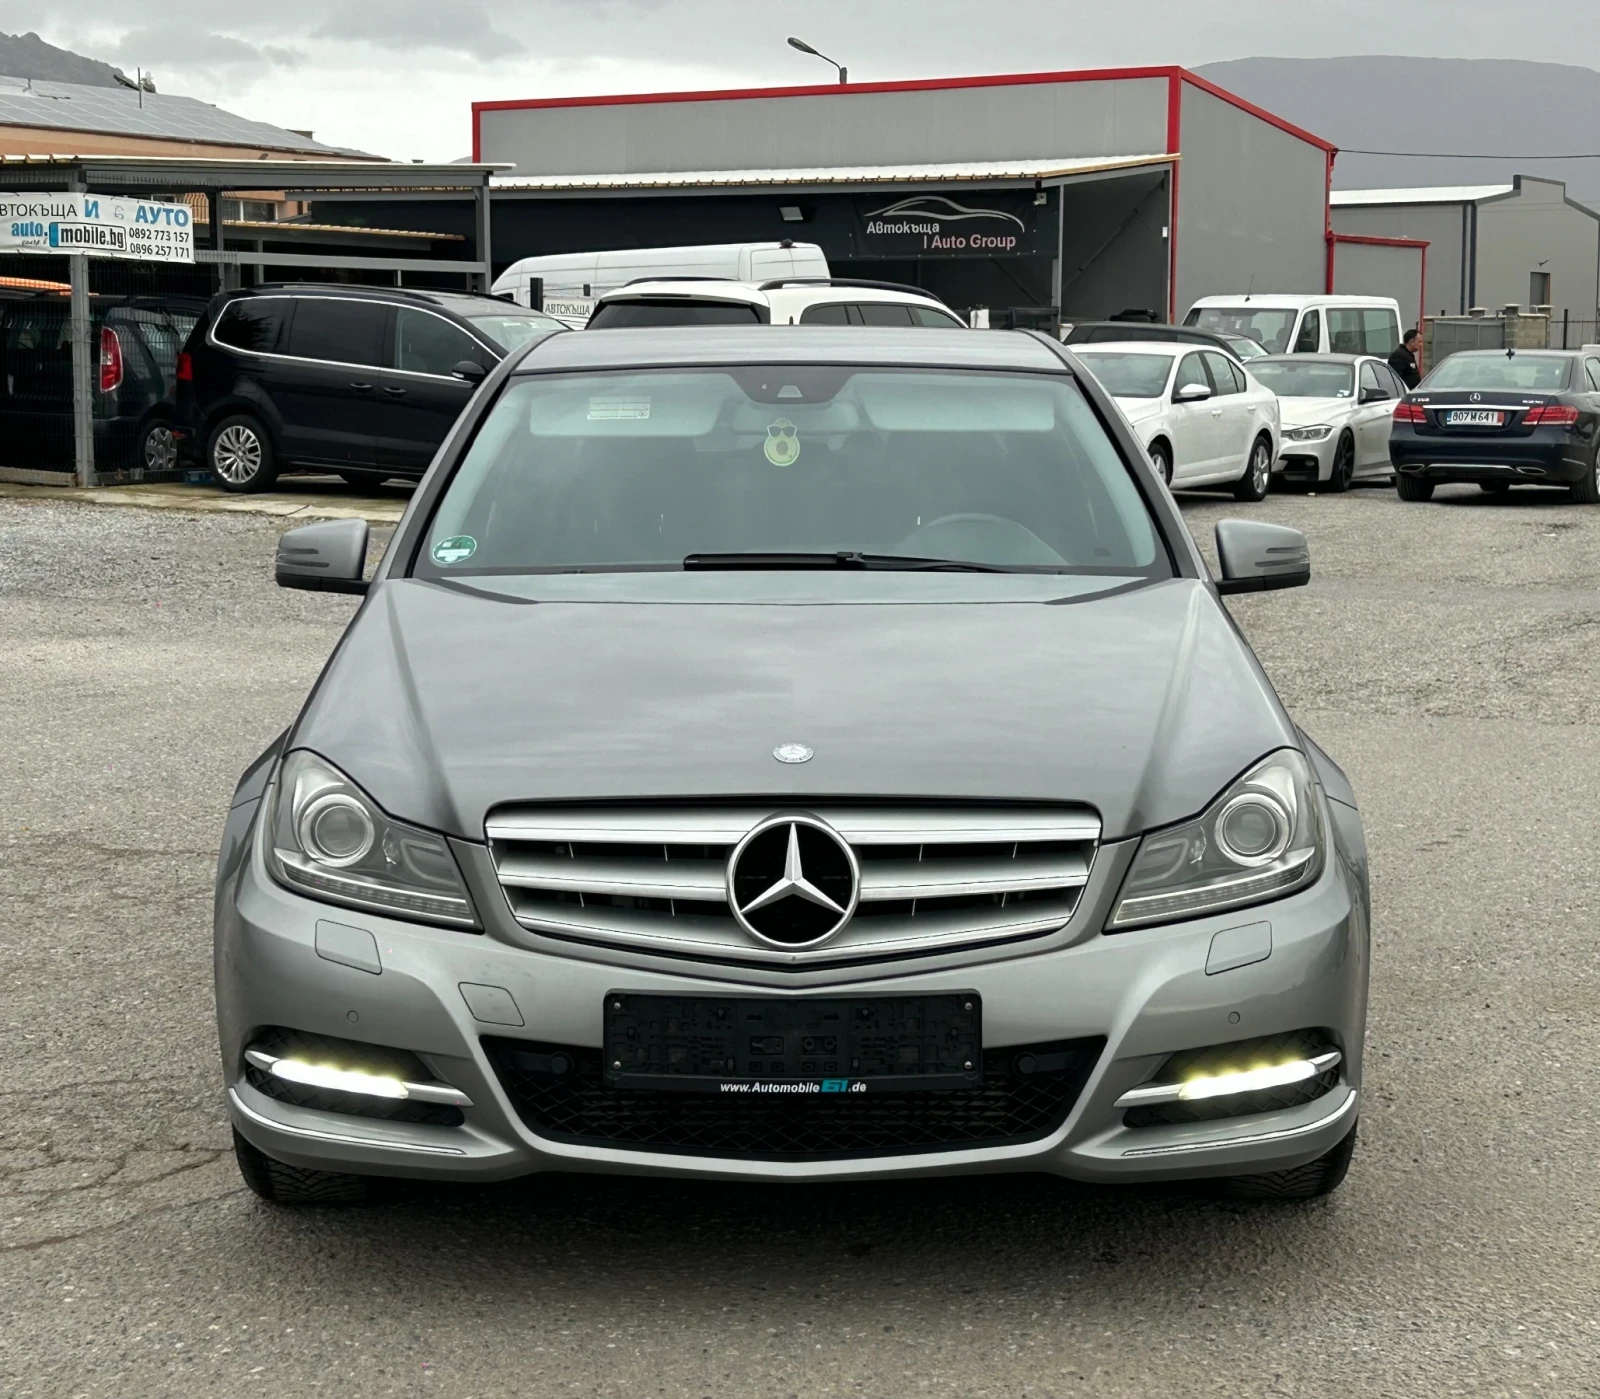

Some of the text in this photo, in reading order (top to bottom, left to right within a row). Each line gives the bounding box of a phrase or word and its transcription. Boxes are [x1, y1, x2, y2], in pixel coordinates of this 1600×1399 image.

[0, 203, 78, 219] ВТОКЪЩА
[135, 205, 189, 227] АУТО
[129, 227, 189, 242] 0892 773 157
[866, 221, 940, 235] Автокъща
[931, 235, 967, 249] Auto
[970, 234, 1016, 251] Group
[129, 243, 189, 258] 0896 257 171
[545, 303, 590, 315] АВТОКЪЩА
